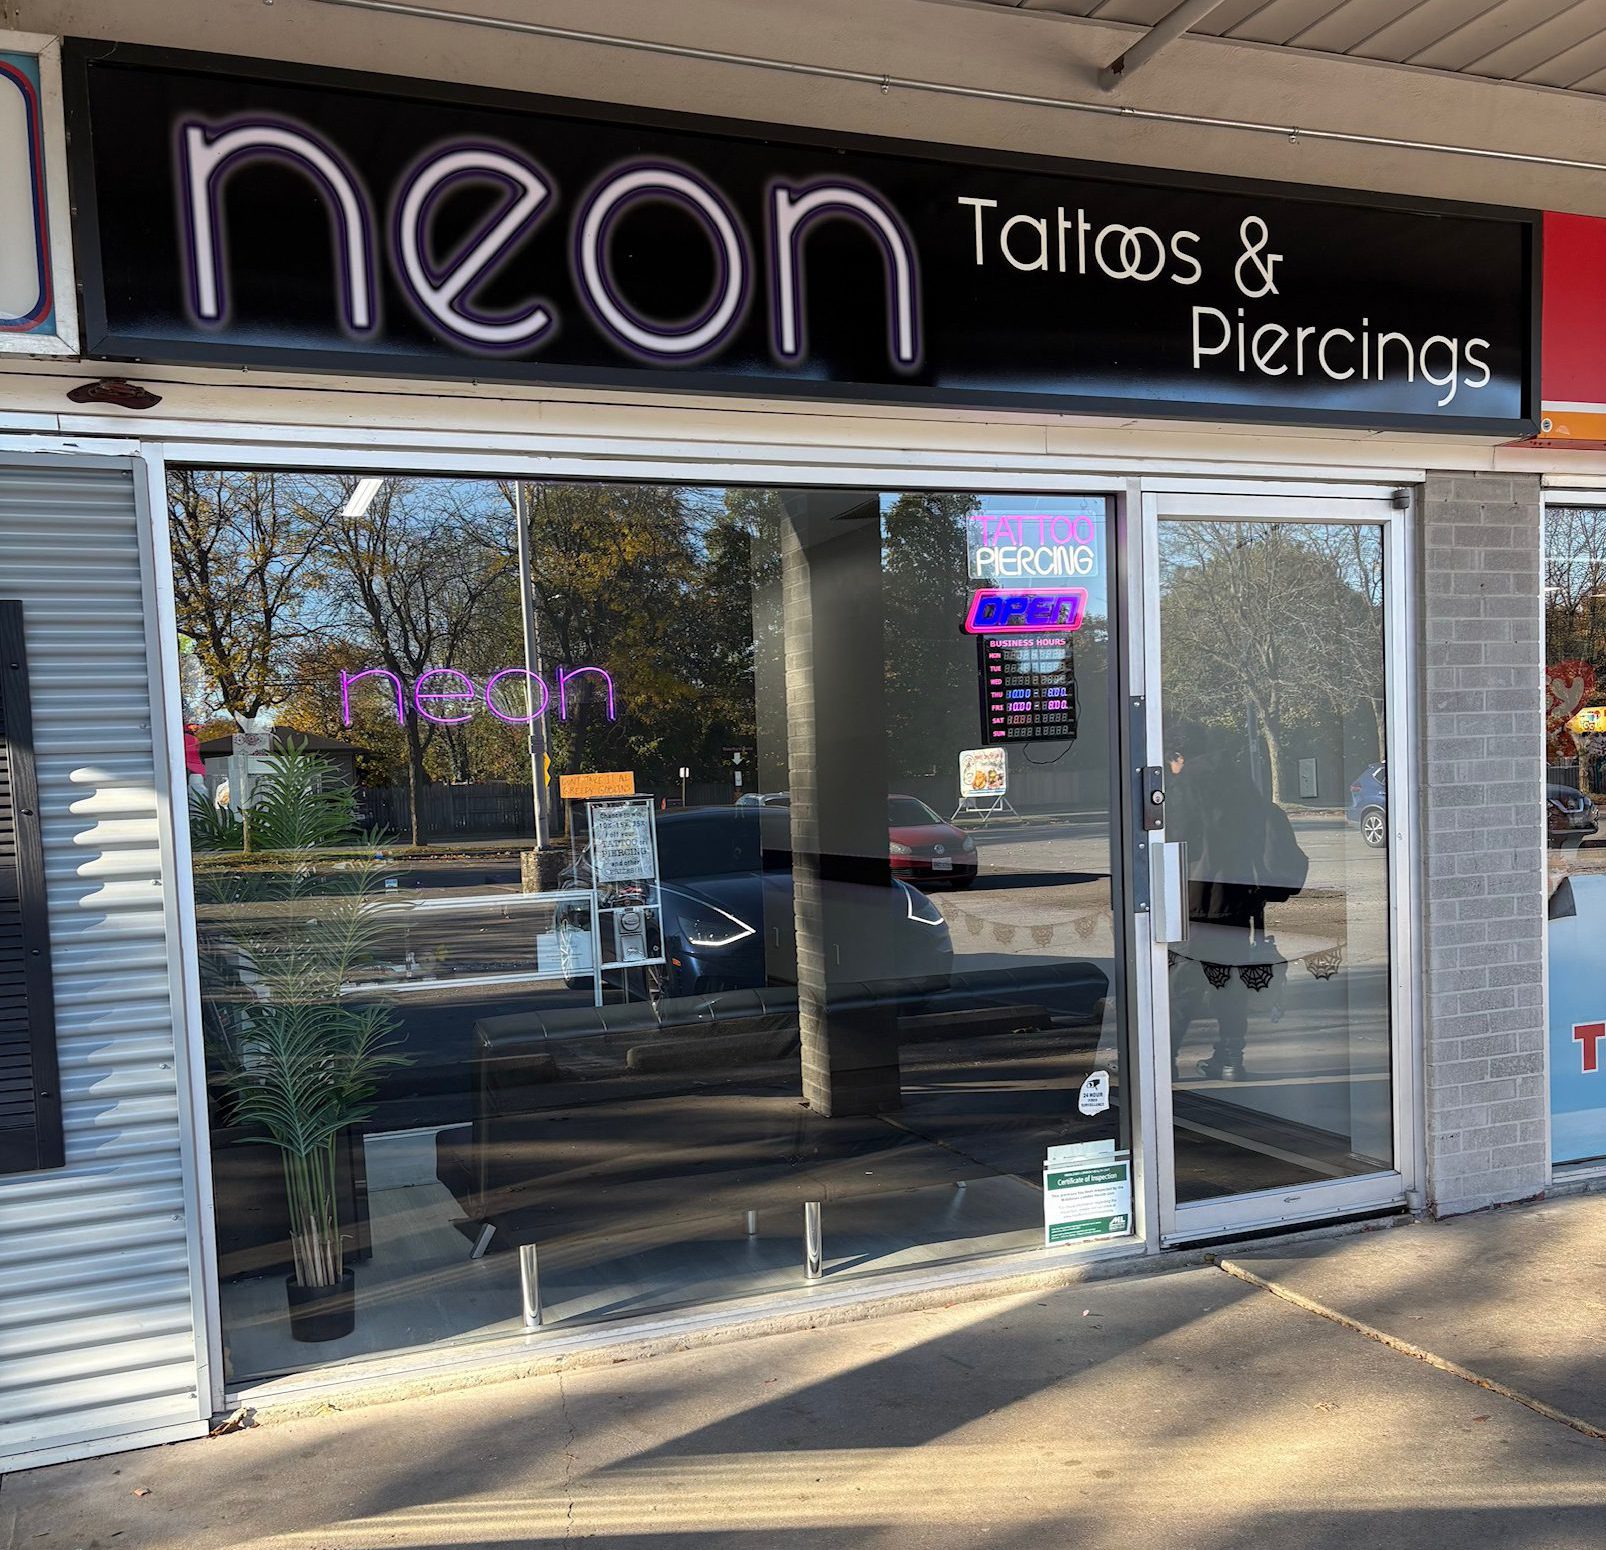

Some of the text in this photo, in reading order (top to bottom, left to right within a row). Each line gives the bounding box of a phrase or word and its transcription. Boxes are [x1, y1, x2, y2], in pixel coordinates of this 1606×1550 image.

[184, 124, 917, 366] neon
[958, 196, 1283, 298] Tattoos &
[1192, 306, 1491, 407] Piercings
[971, 515, 1095, 547] TATTOO
[976, 545, 1095, 577] PIERCING
[989, 638, 1066, 648] BUSINESS HOURS
[340, 666, 617, 728] neon
[601, 847, 648, 858] PIERCING
[602, 839, 638, 848] TATTOO
[1057, 1177, 1084, 1186] Certificate
[1084, 1174, 1091, 1182] of
[1091, 1172, 1118, 1182] Inspection
